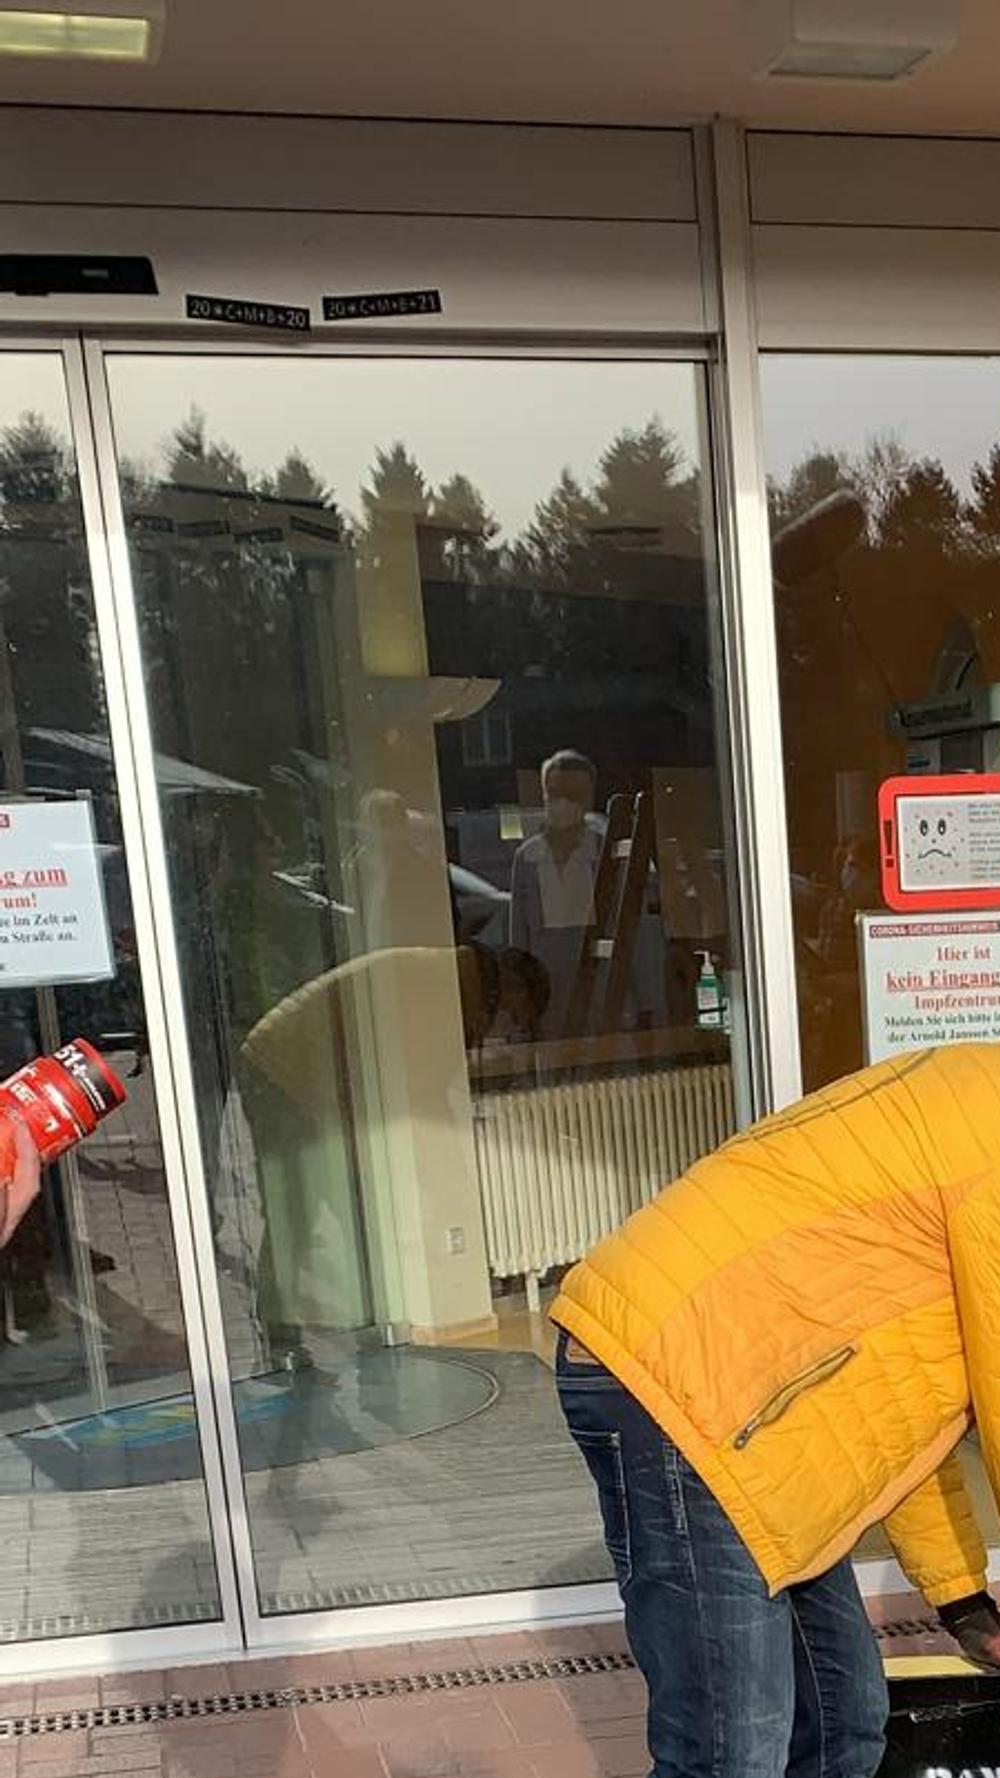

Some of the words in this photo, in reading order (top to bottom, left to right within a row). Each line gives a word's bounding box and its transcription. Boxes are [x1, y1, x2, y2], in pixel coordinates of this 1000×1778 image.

[23, 869, 67, 886] zum
[937, 946, 968, 962] Hier
[973, 945, 991, 960] ist
[886, 971, 923, 990] kein
[930, 969, 1000, 989] Eingang
